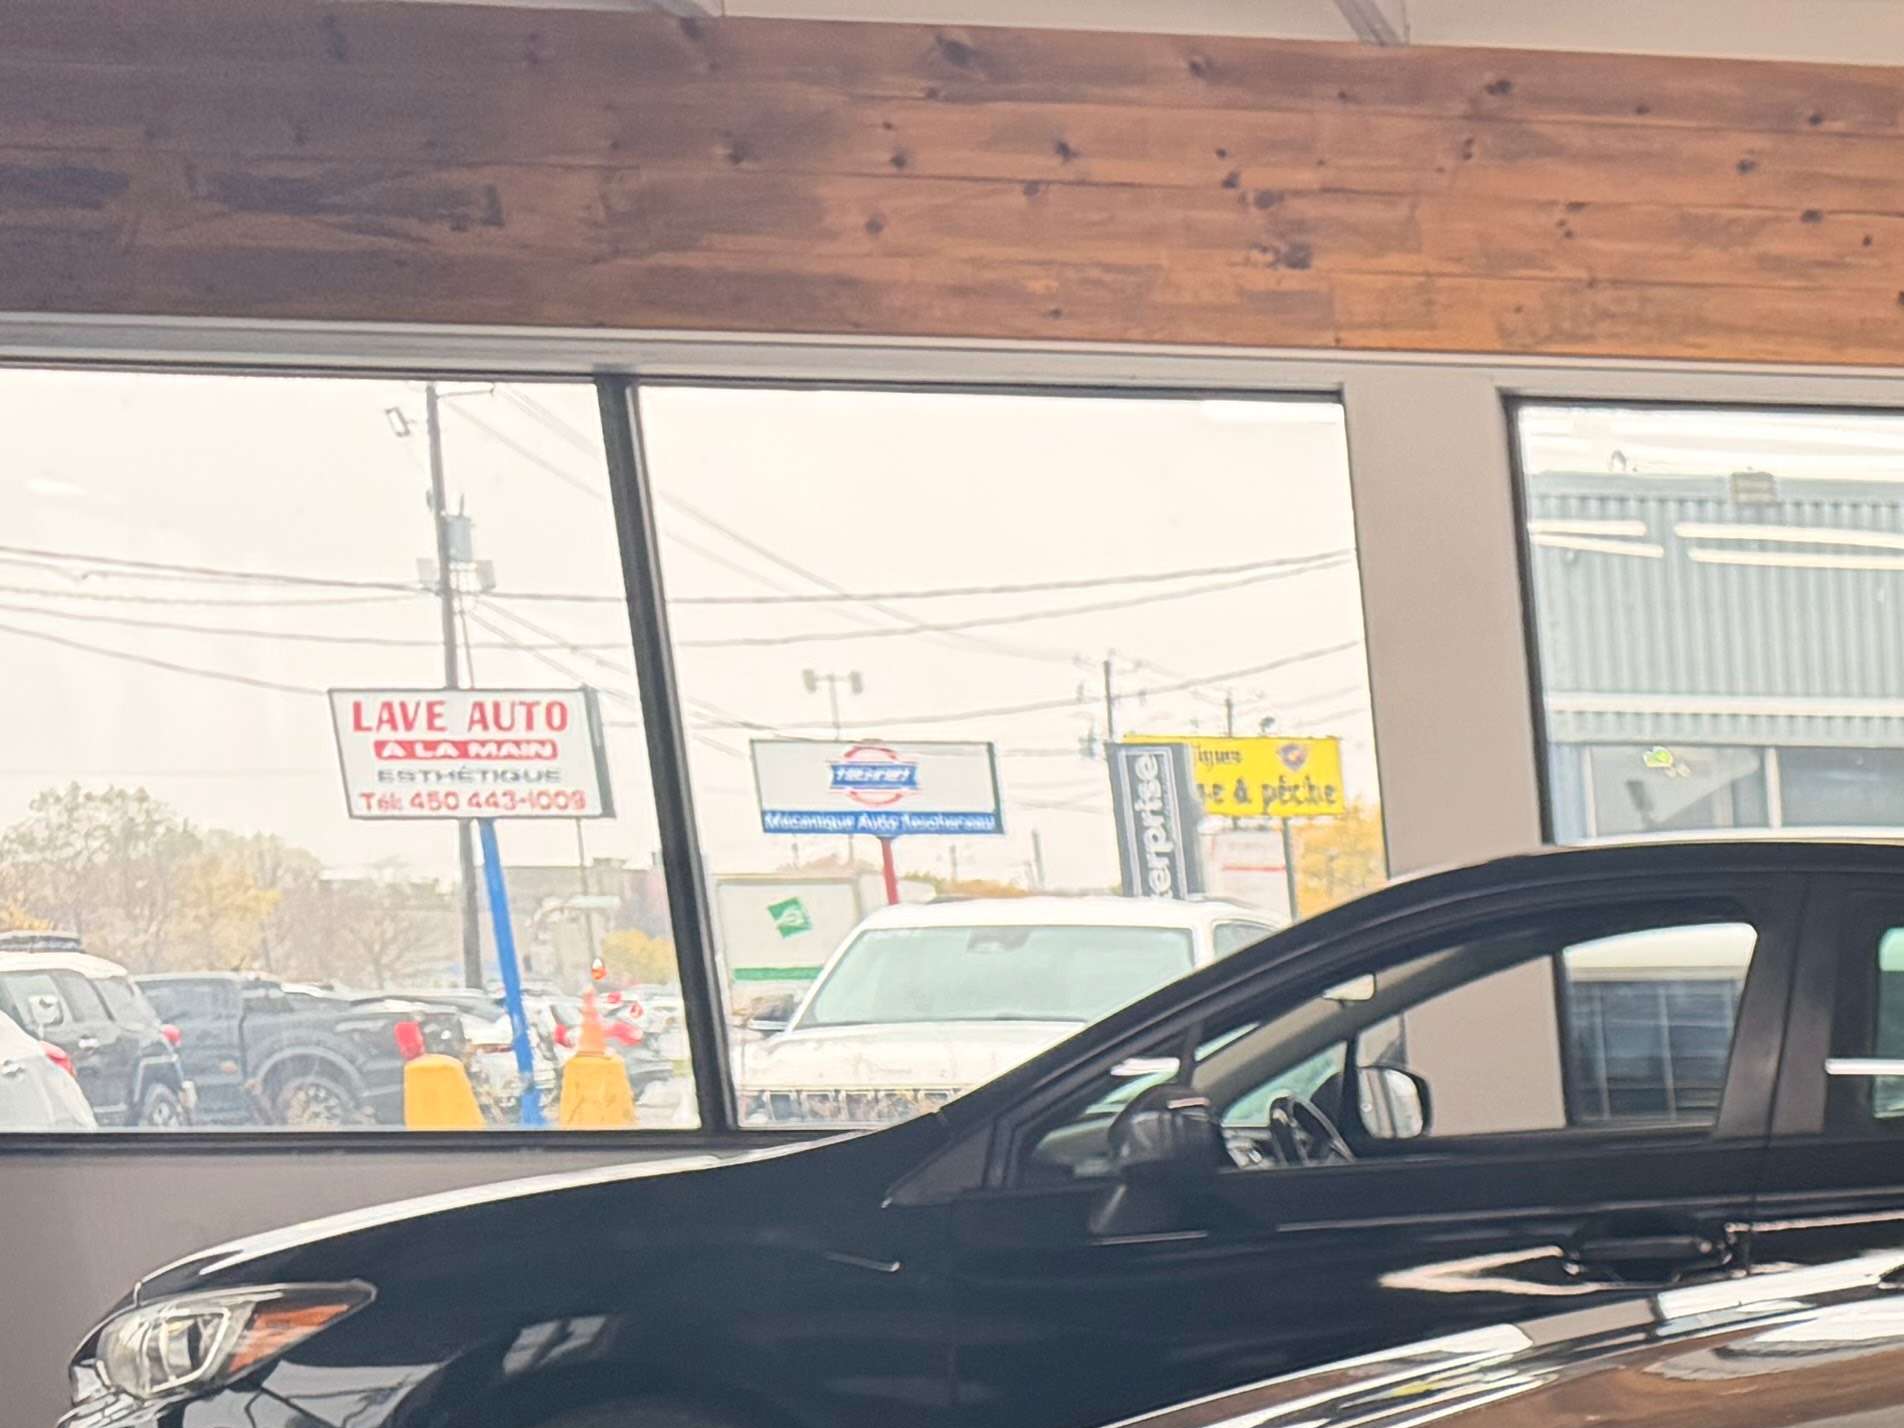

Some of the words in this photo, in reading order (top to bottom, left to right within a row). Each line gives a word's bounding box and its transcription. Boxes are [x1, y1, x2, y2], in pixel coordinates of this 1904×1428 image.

[352, 699, 448, 733] LAVE
[467, 699, 568, 733] AUTO
[412, 740, 461, 759] LA
[467, 740, 556, 759] MAIN
[377, 765, 562, 784] ESTHÉTIQUE
[409, 791, 460, 812] 450
[857, 813, 898, 831] Auto
